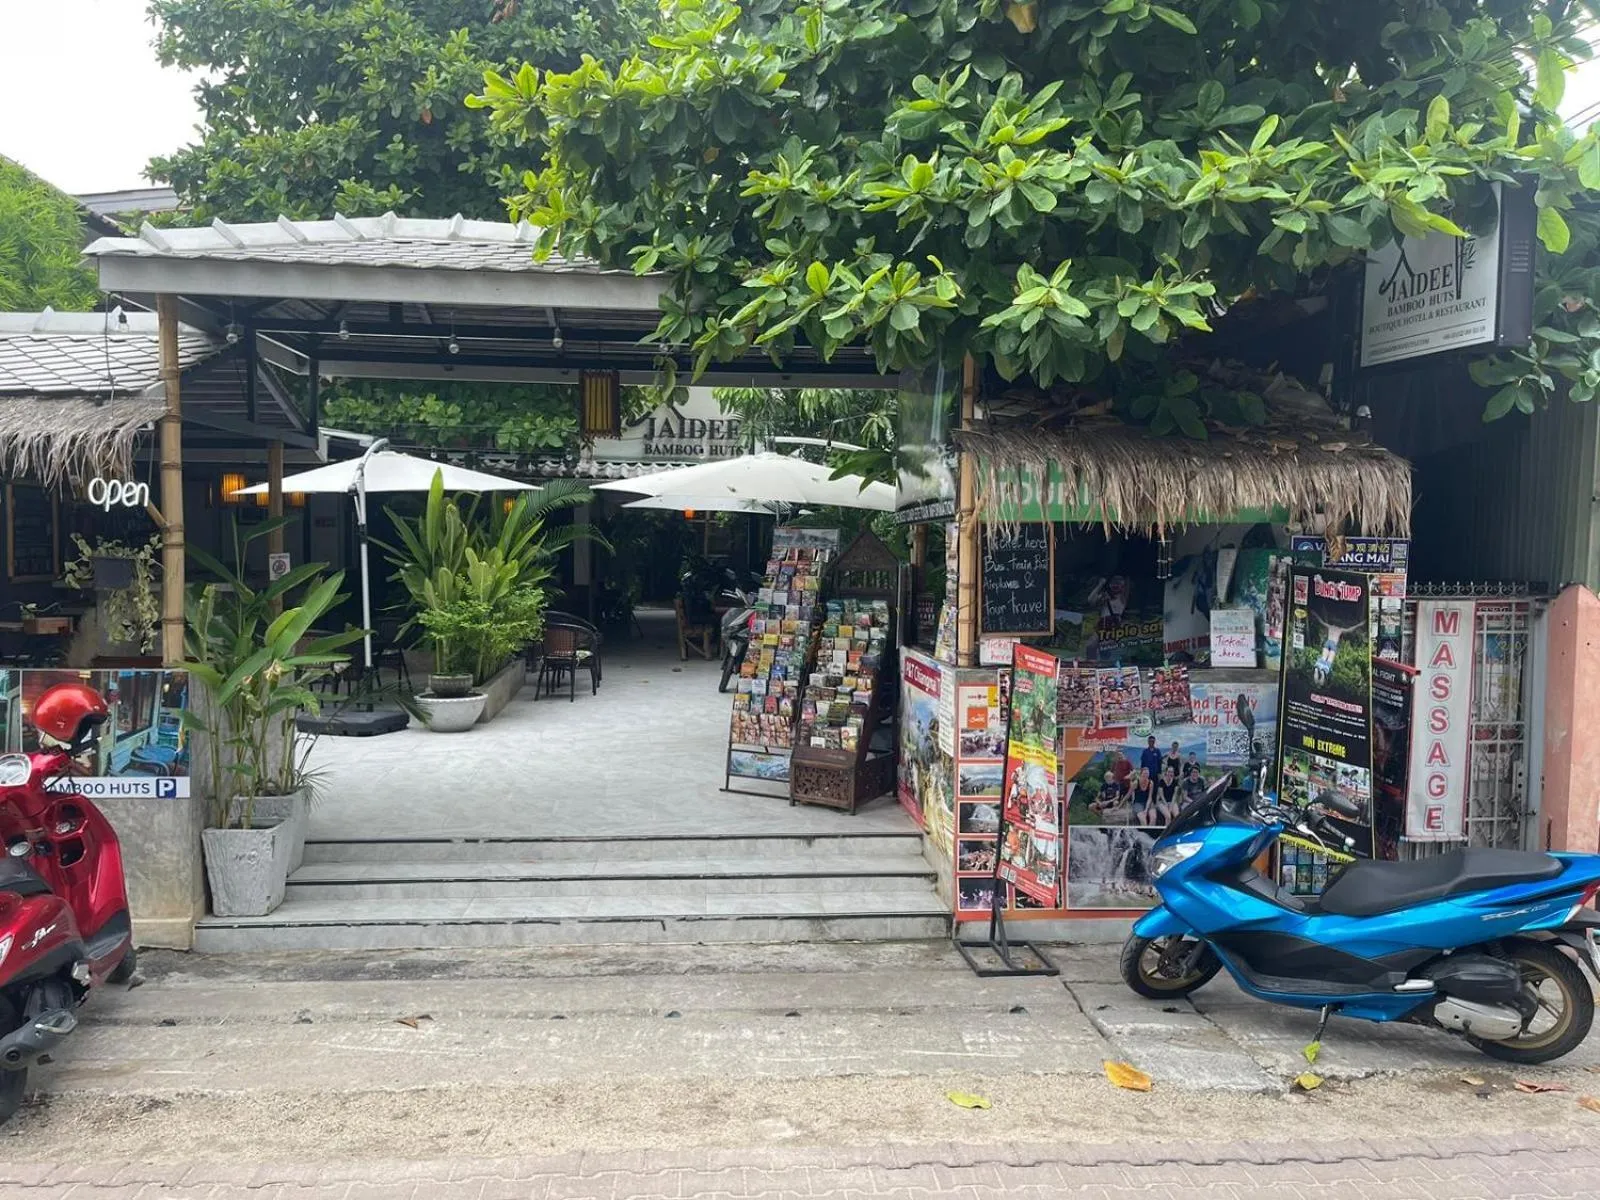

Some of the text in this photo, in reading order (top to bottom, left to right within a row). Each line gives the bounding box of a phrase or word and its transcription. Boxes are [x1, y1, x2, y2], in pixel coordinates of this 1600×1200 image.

[1388, 264, 1454, 303] JAIDEE
[1387, 289, 1455, 318] BAMBOO HUTS
[1435, 297, 1487, 318] RESTAURANT
[644, 443, 745, 457] BAMBOO HUTS
[1367, 554, 1390, 564] MAI
[1100, 623, 1139, 643] Triple
[1424, 608, 1462, 832] MASSAGE
[44, 782, 105, 795] AMBOO
[110, 782, 150, 795] HUTS
